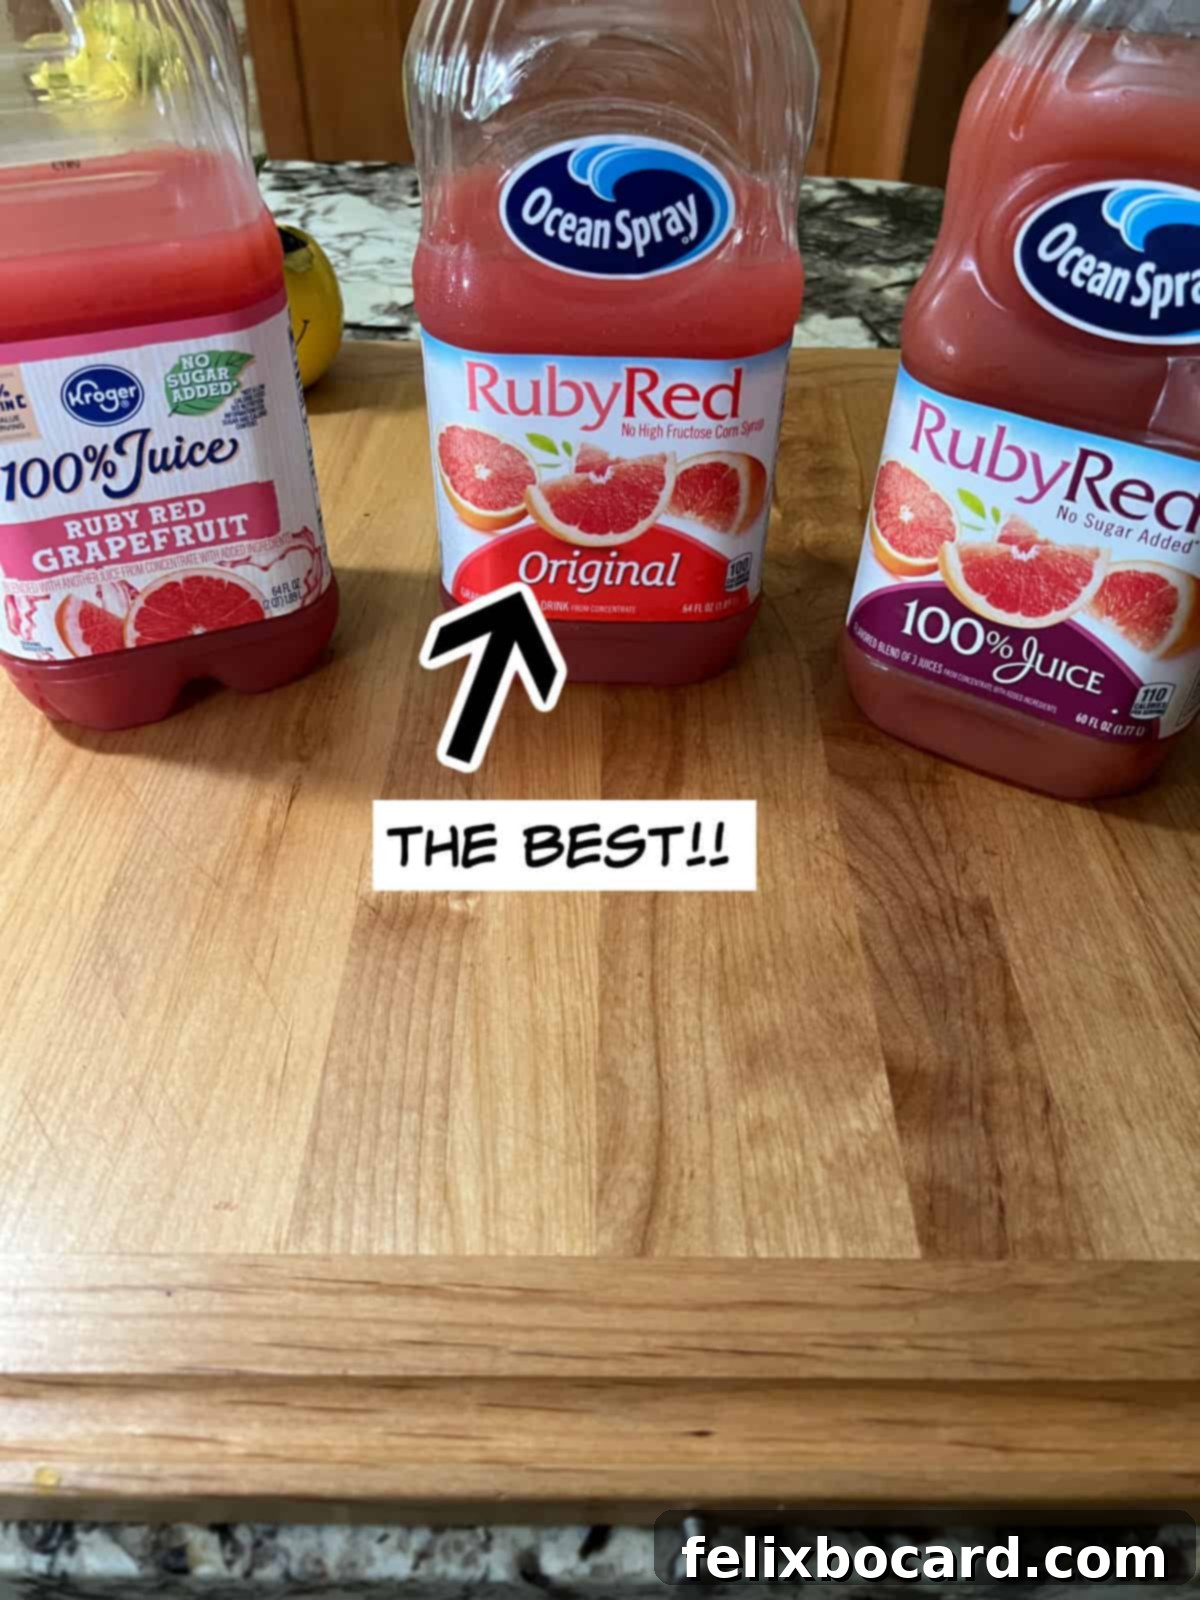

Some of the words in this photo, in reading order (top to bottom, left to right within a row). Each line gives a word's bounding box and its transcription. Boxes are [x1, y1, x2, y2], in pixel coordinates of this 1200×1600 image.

[521, 187, 611, 249] Ocean
[615, 193, 699, 258] Spray
[1037, 222, 1131, 304] Ocean
[166, 367, 229, 388] SUGAR
[181, 353, 210, 370] NO
[68, 380, 137, 413] Kroger
[622, 423, 635, 437] No
[639, 424, 663, 440] High
[667, 424, 712, 439] Fructose
[715, 424, 738, 438] Corn
[1, 444, 117, 501] 100%
[103, 428, 239, 500] Juice
[64, 508, 140, 540] RUBY
[149, 499, 206, 525] RED
[1056, 505, 1078, 524] No
[1083, 512, 1134, 538] Sugar
[32, 514, 249, 573] GRAPEFRUIT
[121, 563, 143, 578] FROM
[145, 551, 199, 574] CONCENTRATE
[518, 550, 681, 593] Original
[730, 556, 749, 577] 100
[271, 585, 283, 597] 64
[540, 600, 569, 612] DRINK
[900, 598, 1013, 660] 100%
[877, 641, 900, 659] BLEND
[901, 650, 911, 662] OF
[911, 654, 918, 665] 3
[918, 657, 943, 674] JUICES
[1141, 687, 1168, 702] 110
[1075, 712, 1088, 725] 60
[1088, 716, 1098, 729] FL
[1100, 720, 1113, 733] OZ
